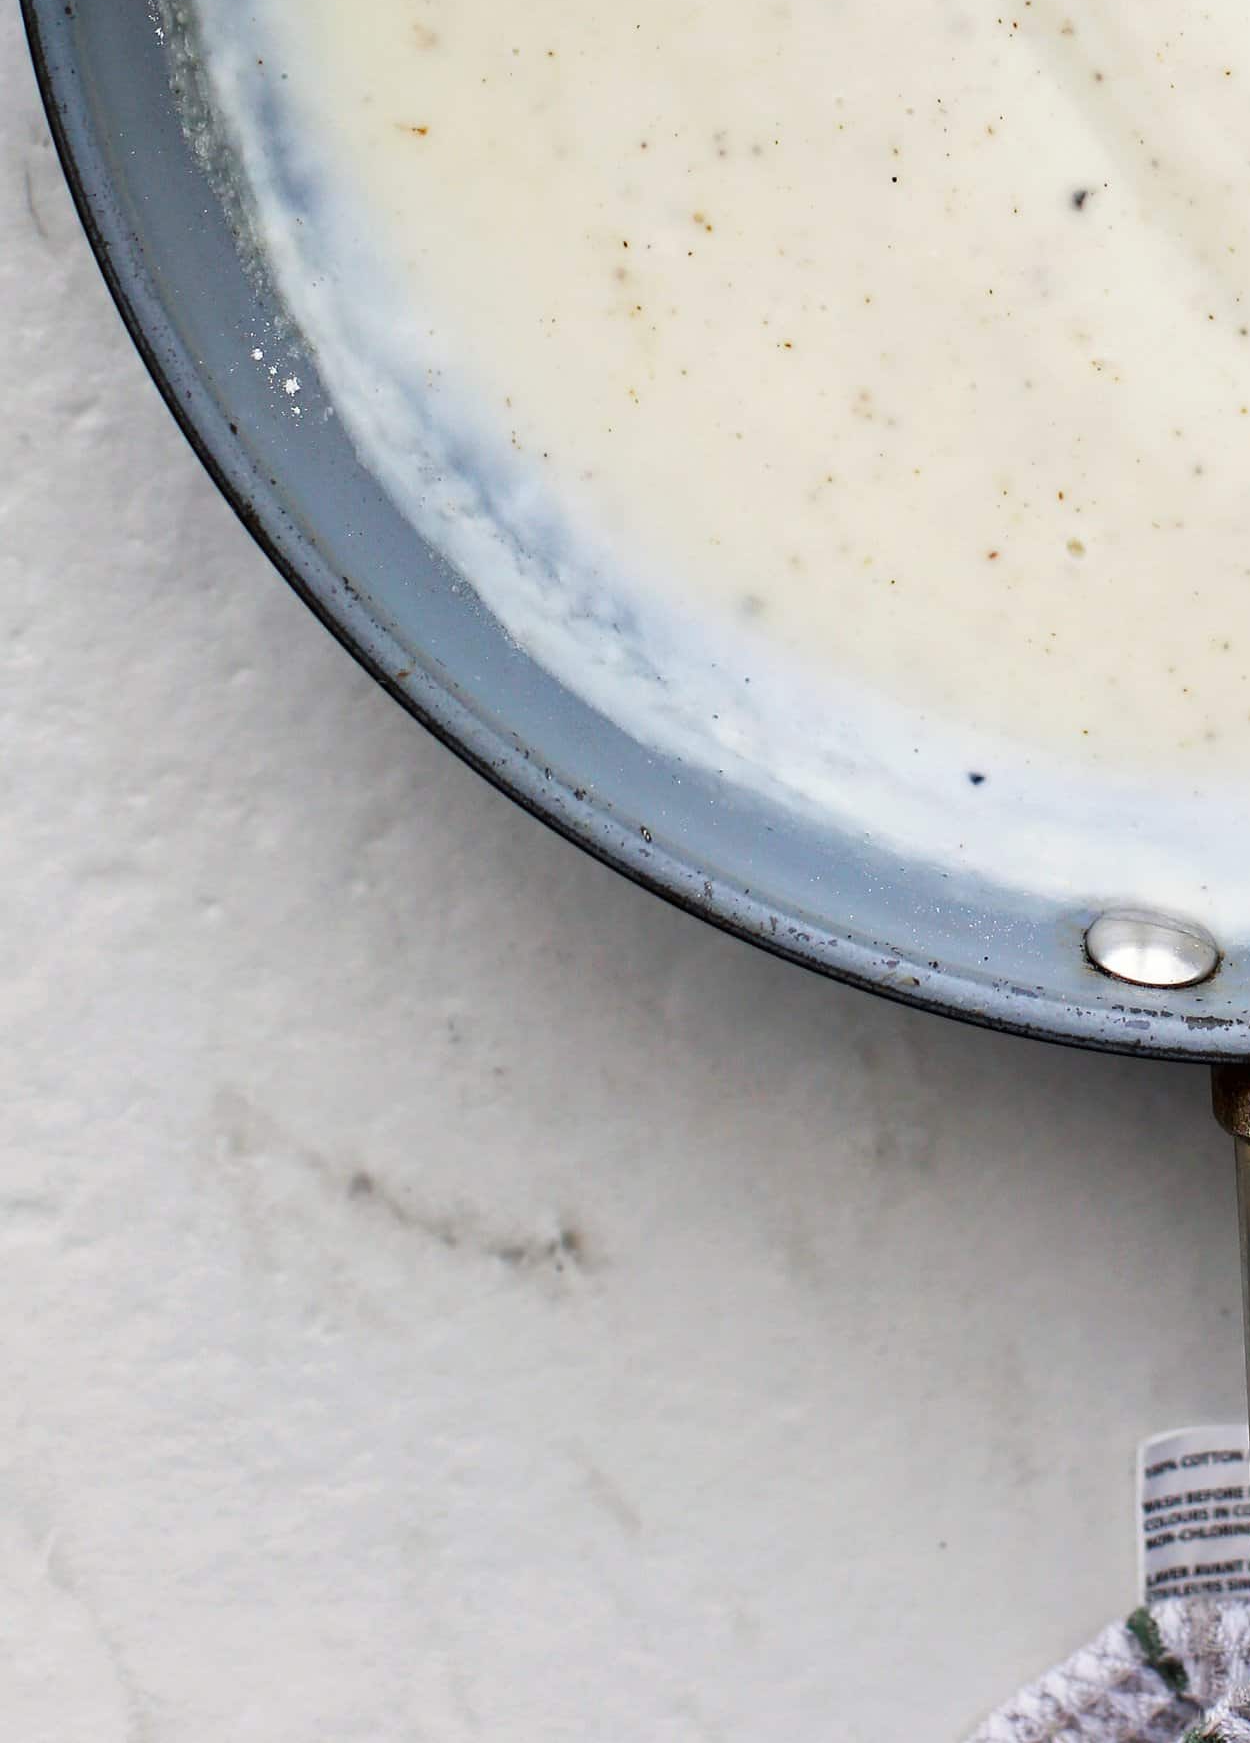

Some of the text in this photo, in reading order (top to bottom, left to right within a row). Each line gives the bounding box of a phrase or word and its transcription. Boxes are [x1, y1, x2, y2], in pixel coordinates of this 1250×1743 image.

[1181, 1451, 1243, 1467] COTTON
[1143, 1494, 1182, 1514] WASH
[1186, 1487, 1243, 1503] BEFORE
[1144, 1507, 1208, 1531] COLOURS
[1214, 1507, 1228, 1518] IN
[1195, 1559, 1244, 1575] AVANT
